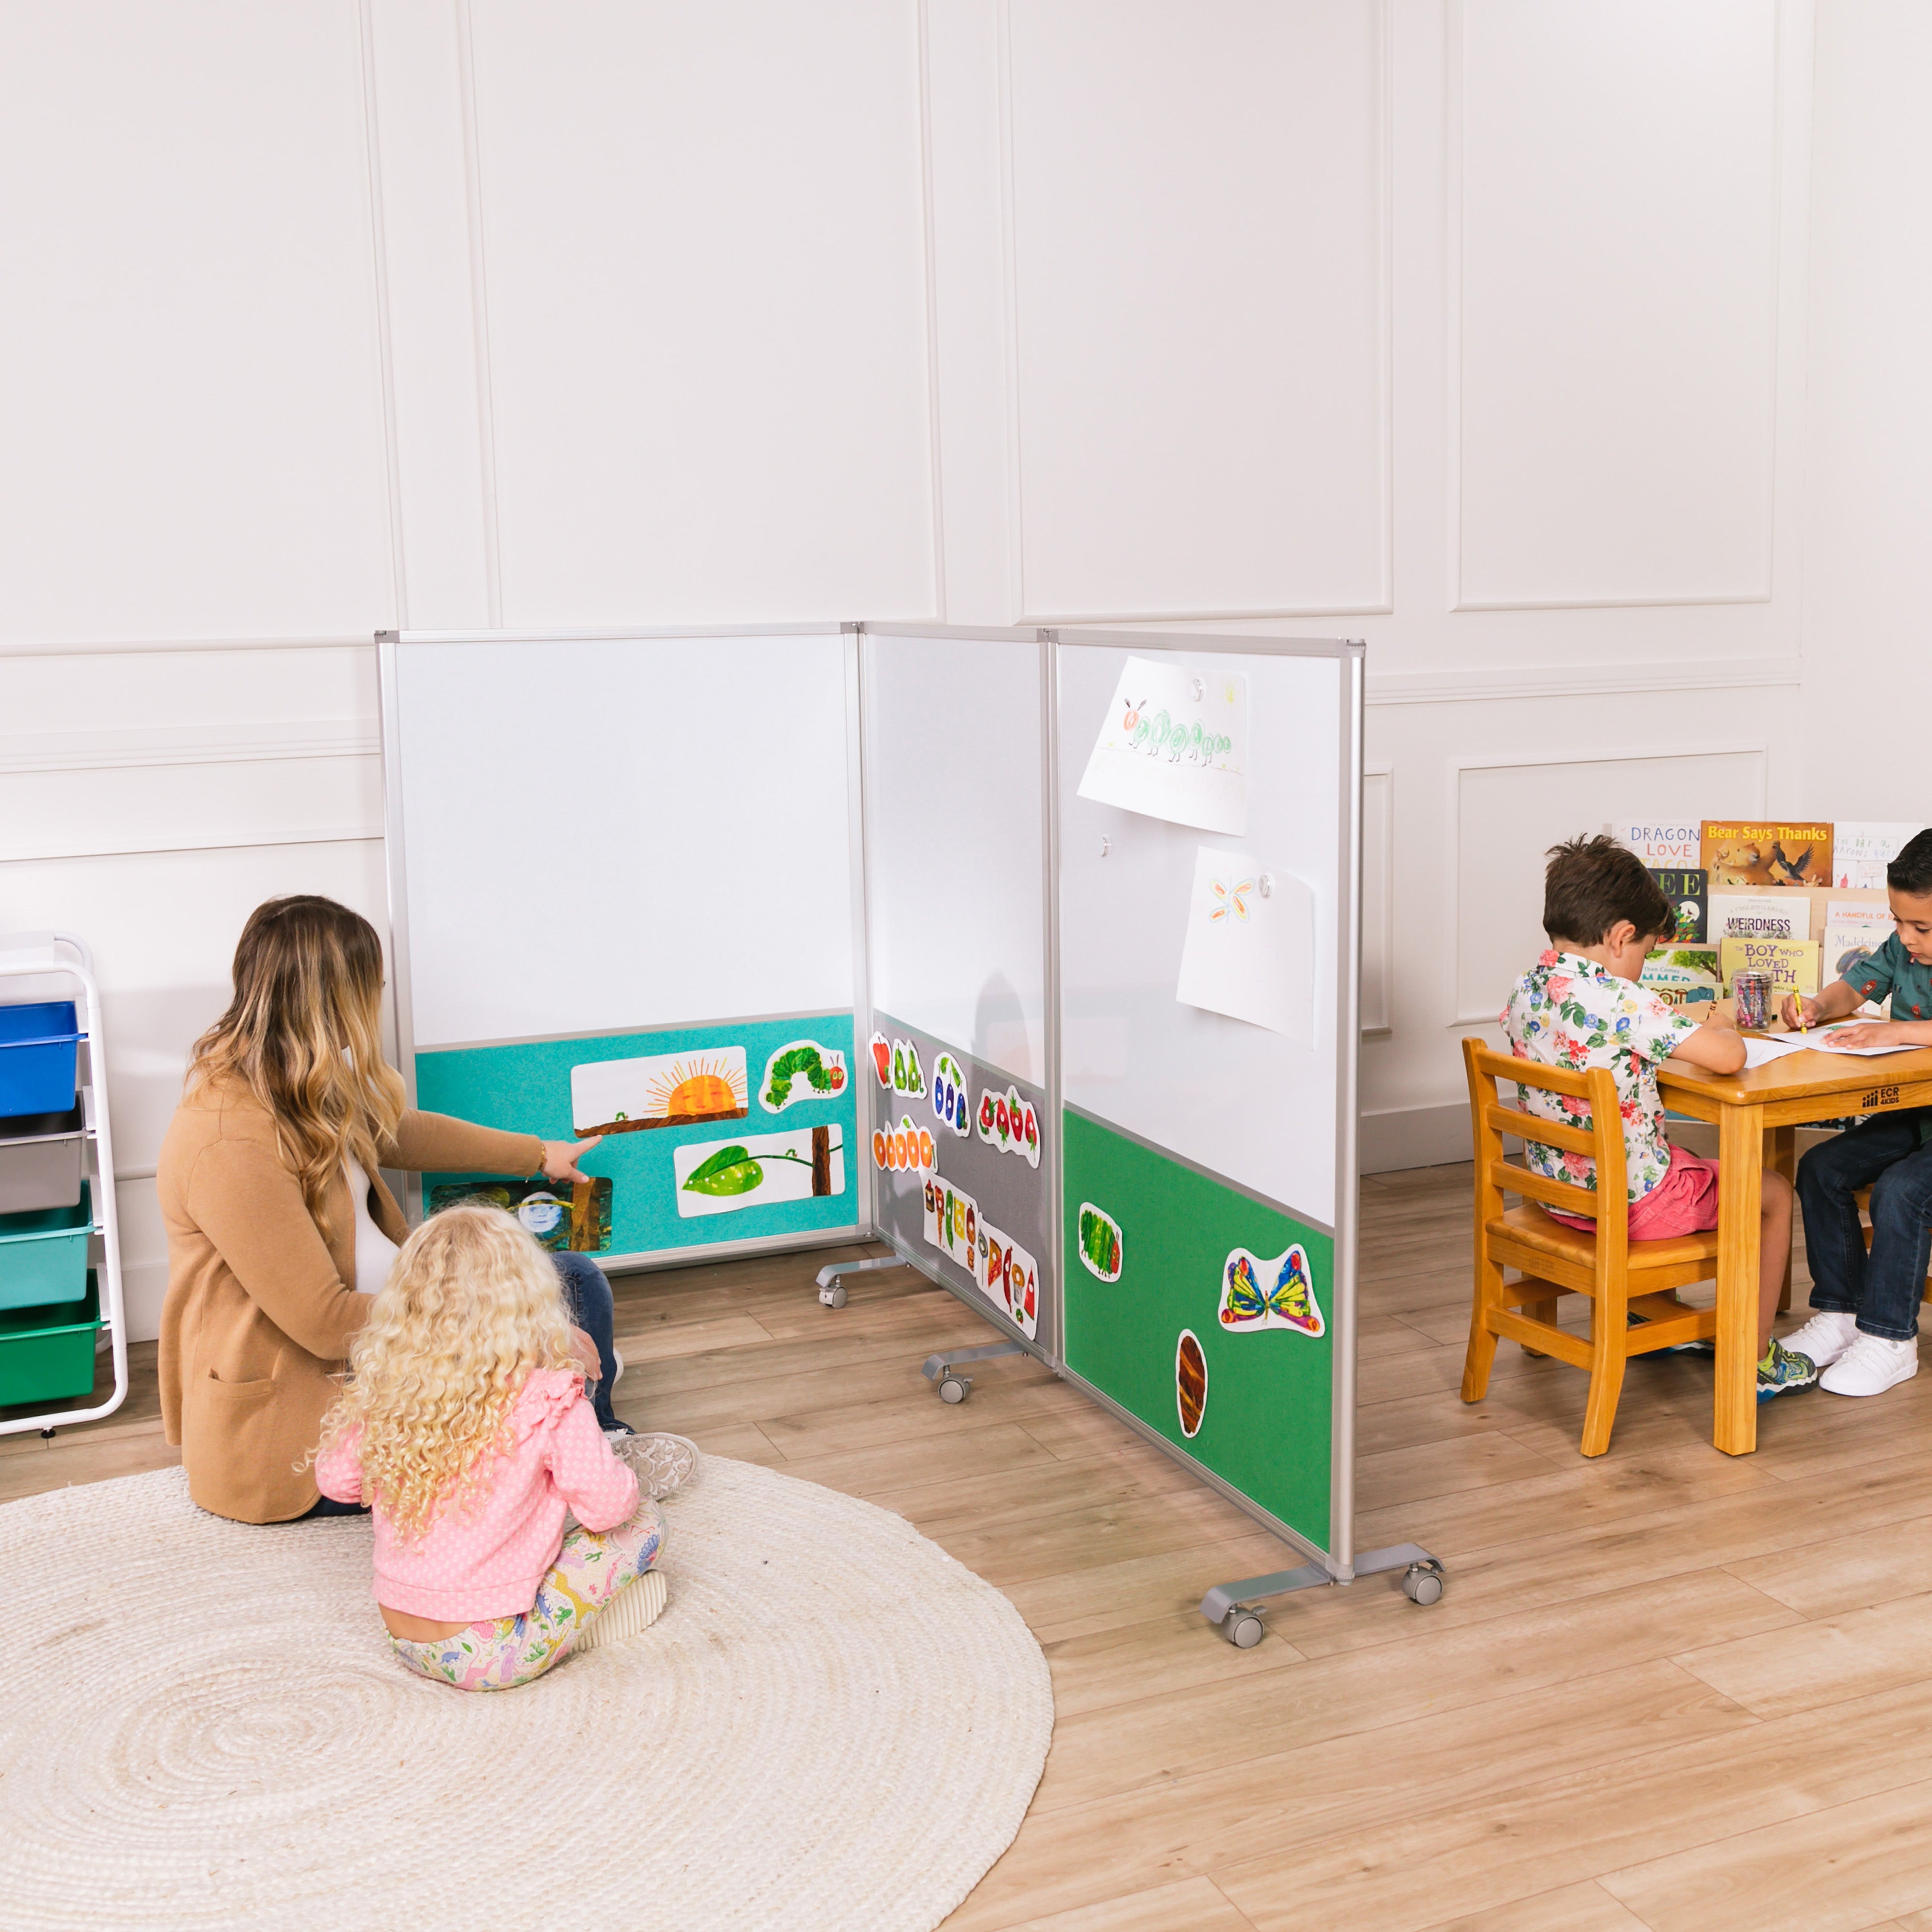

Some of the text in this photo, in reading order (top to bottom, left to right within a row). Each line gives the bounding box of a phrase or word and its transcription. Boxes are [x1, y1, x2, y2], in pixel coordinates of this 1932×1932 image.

[1631, 827, 1700, 841] DRAGON
[1707, 825, 1827, 843] Bear Says Thanks
[1647, 843, 1692, 857] LOVE
[1835, 935, 1881, 947] Madeleine
[1745, 944, 1778, 957] BOY
[1747, 957, 1789, 968] LOVED
[1881, 1087, 1899, 1098] ECR
[1880, 1097, 1899, 1105] 4KIDS
